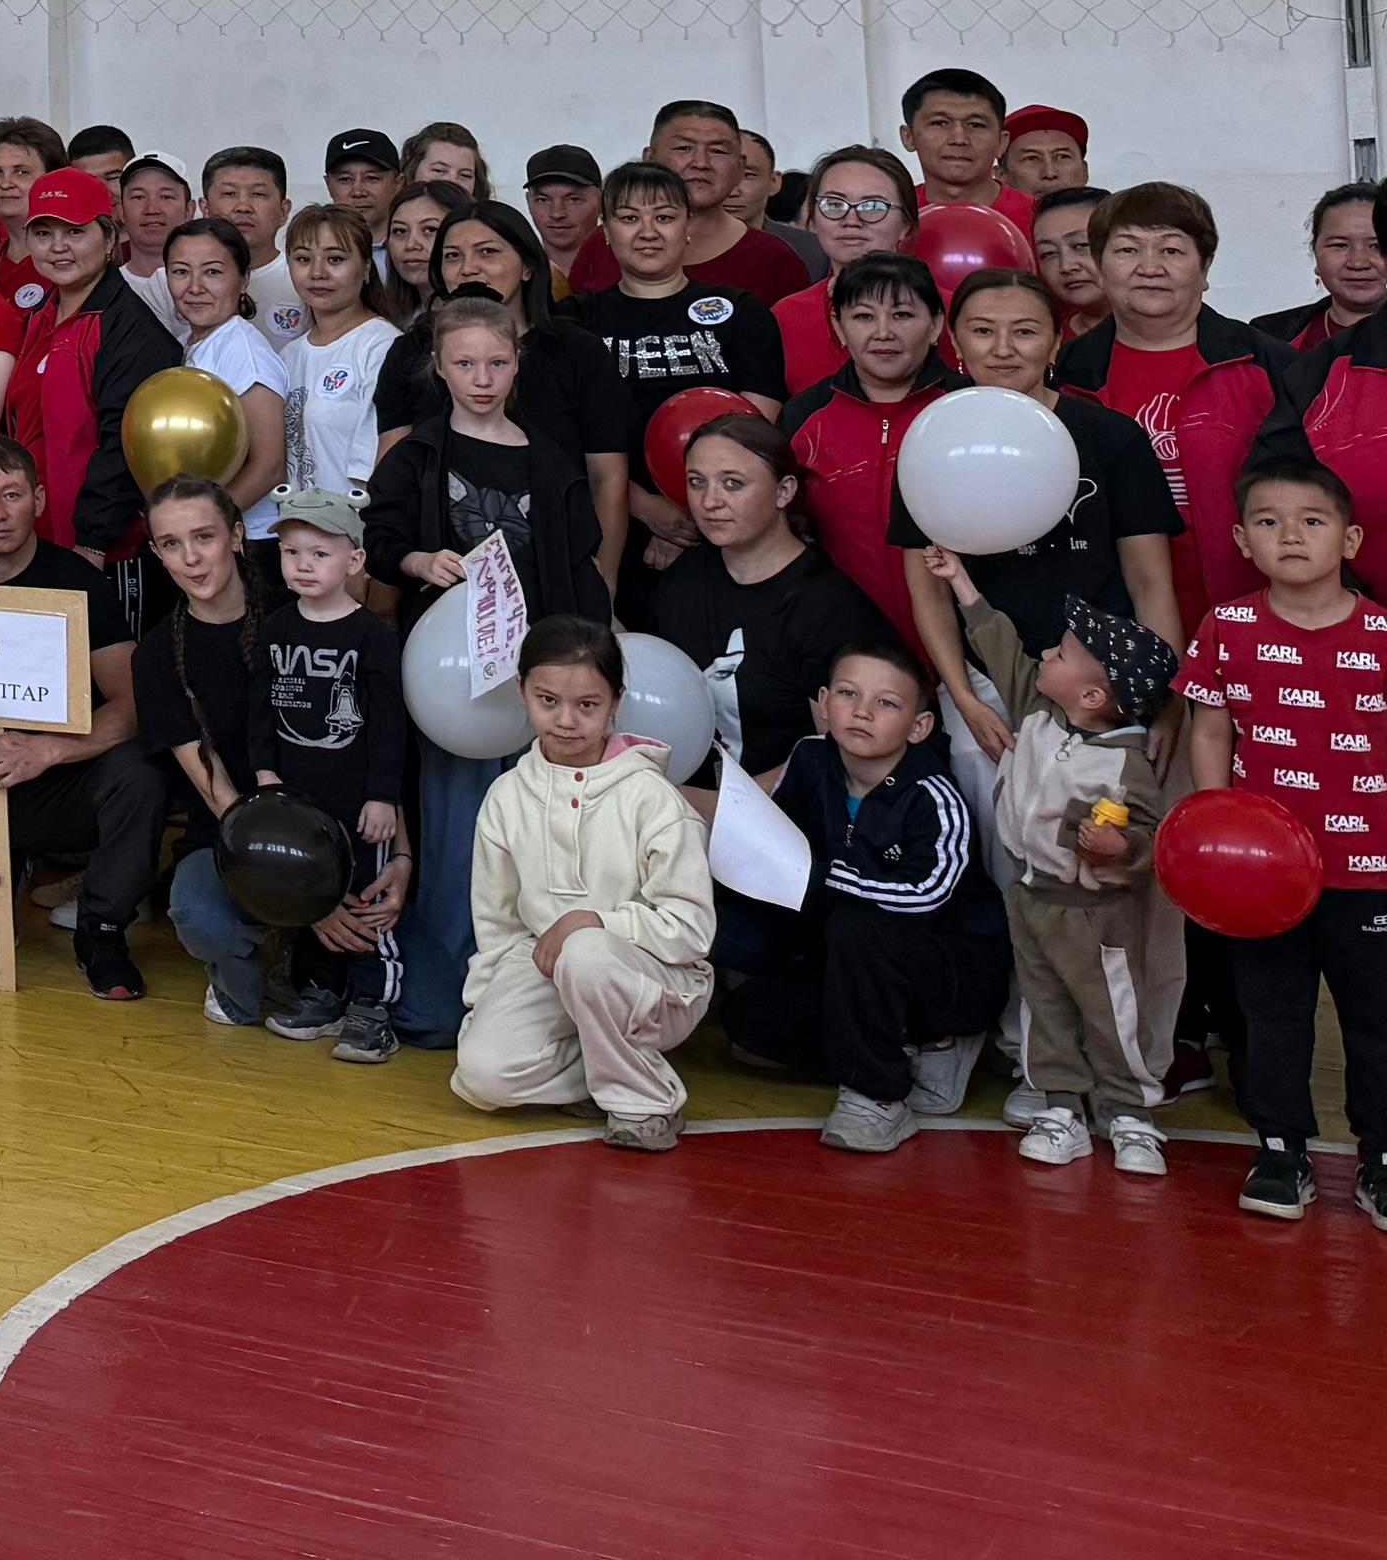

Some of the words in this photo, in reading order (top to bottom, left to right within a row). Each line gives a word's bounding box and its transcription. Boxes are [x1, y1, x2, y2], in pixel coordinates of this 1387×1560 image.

[1257, 643, 1302, 661] KARL
[1336, 651, 1380, 668] KARL
[270, 644, 358, 681] NASA
[1183, 681, 1226, 706] KARL
[1227, 683, 1252, 699] ARL
[1279, 687, 1325, 705] KARL
[1252, 725, 1297, 743] KARL
[1331, 733, 1371, 749] KARL
[1274, 768, 1320, 787] KARL
[1325, 814, 1369, 830] KARL
